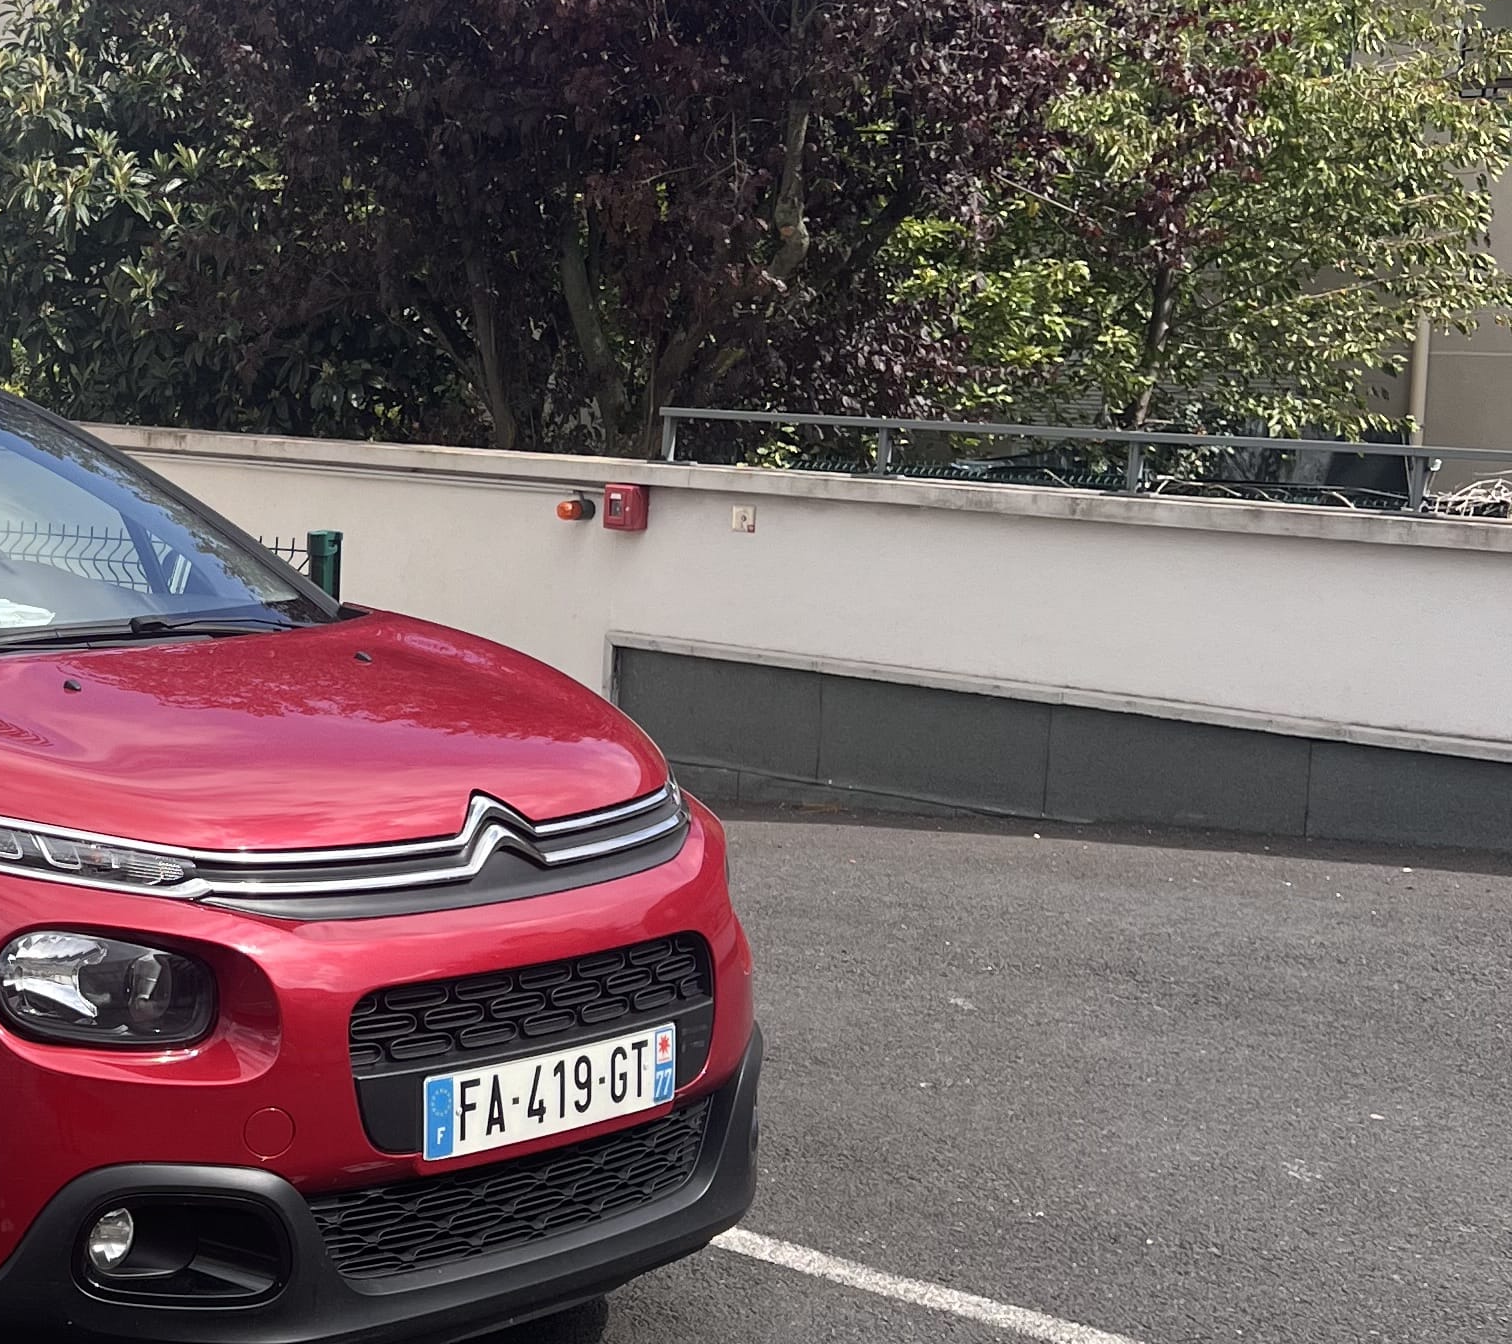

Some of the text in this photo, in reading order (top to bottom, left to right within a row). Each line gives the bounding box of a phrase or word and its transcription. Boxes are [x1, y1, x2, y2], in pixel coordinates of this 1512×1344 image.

[459, 1039, 649, 1141] FA-419-GT
[655, 1067, 672, 1098] 77
[437, 1127, 445, 1146] F
